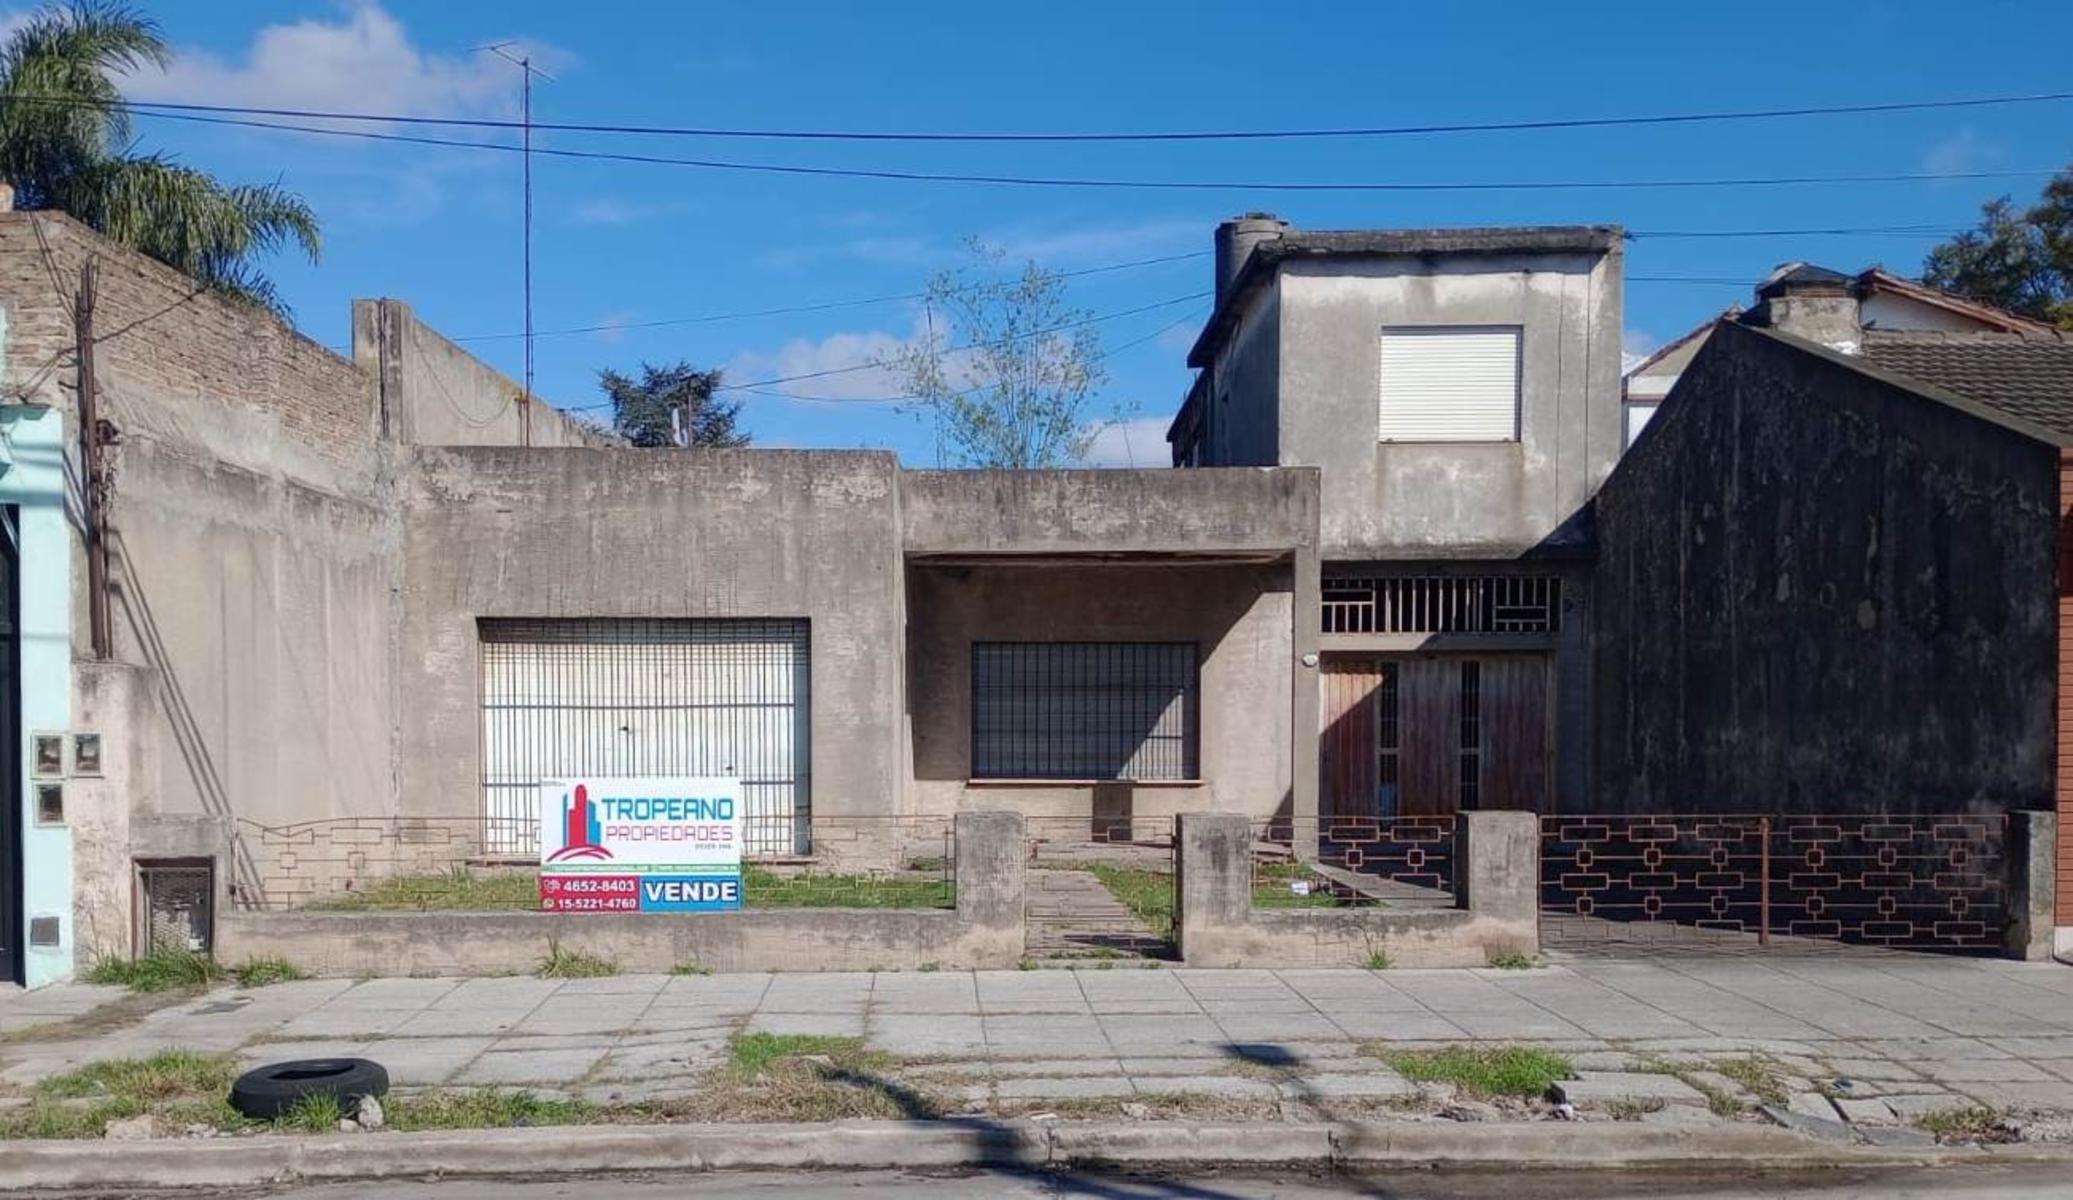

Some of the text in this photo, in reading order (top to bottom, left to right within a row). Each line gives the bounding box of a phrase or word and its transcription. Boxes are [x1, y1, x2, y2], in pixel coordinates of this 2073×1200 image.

[601, 799, 734, 820] TROPEANO
[606, 825, 732, 841] PROPIEDADES
[563, 880, 635, 892] 4652-8403
[645, 881, 737, 902] VENDE
[558, 898, 636, 909] 15-5221-4760
